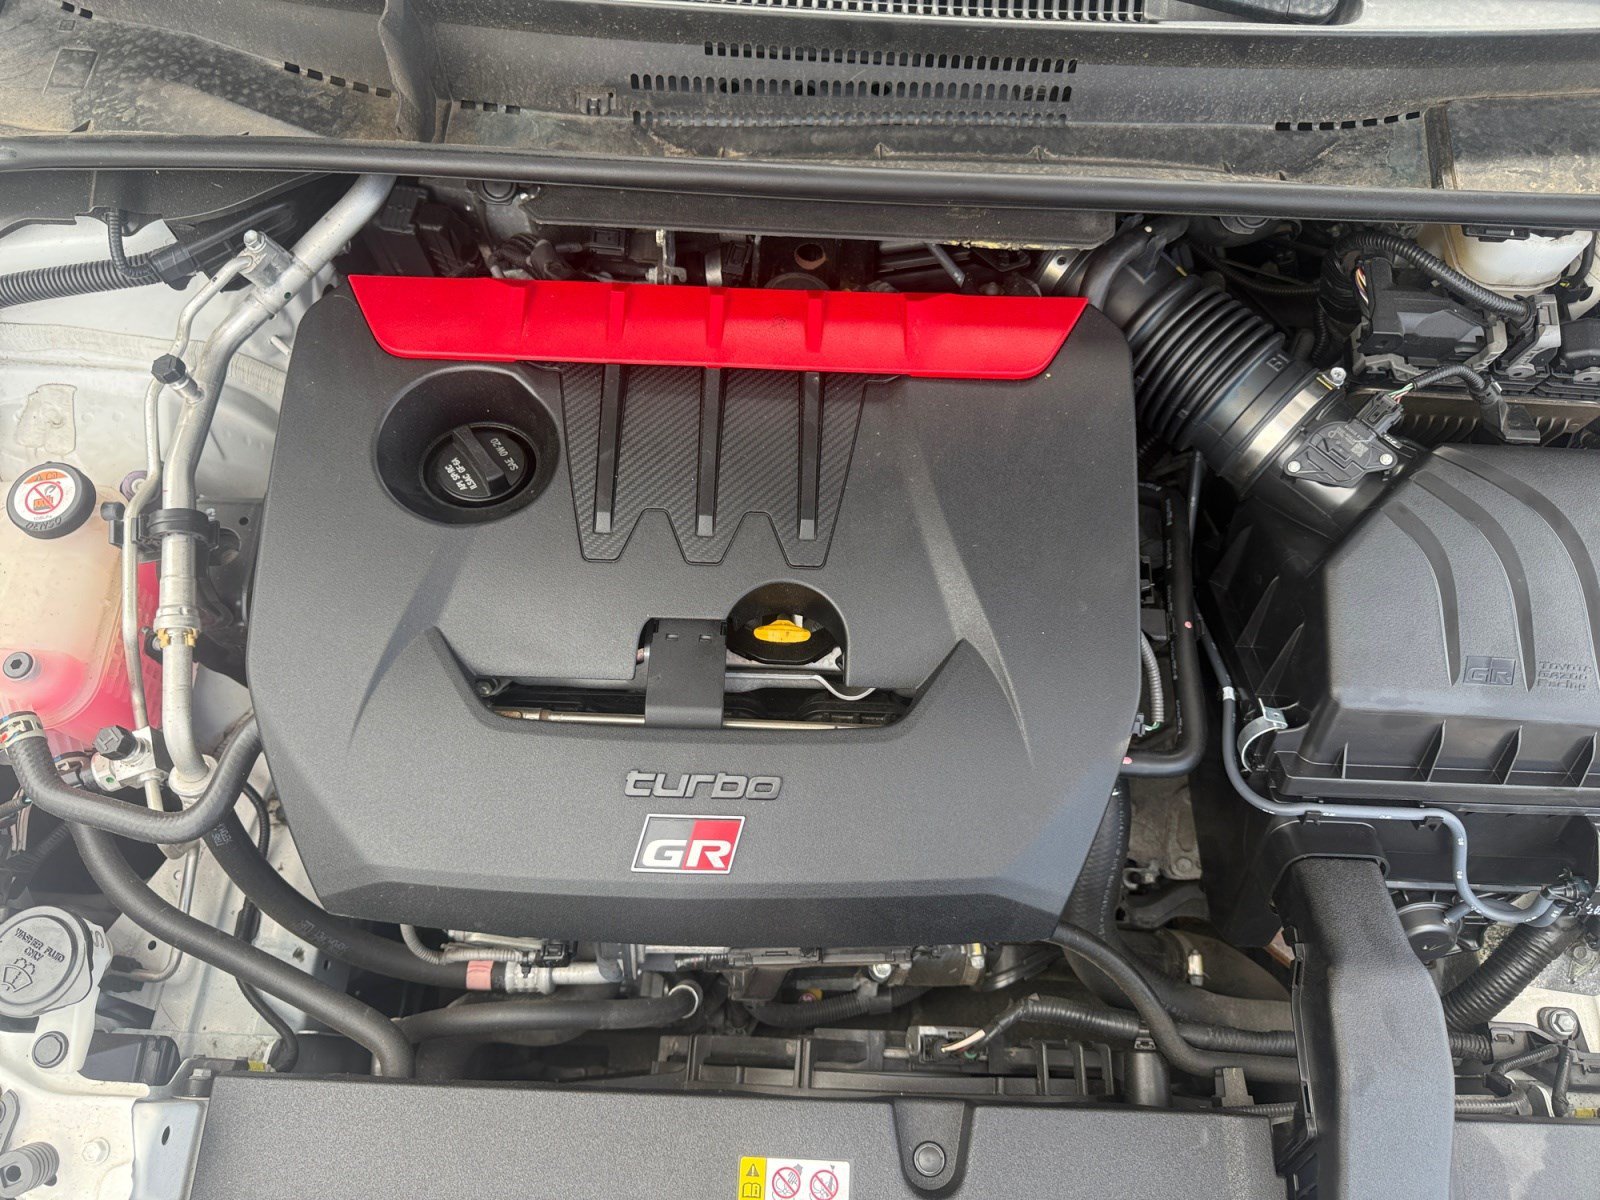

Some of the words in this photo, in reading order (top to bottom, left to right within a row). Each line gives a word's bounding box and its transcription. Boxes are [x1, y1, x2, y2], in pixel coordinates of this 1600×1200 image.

[490, 438, 508, 457] 0W-20
[504, 457, 518, 471] SAE
[1466, 667, 1514, 685] GR
[624, 770, 783, 801] turbo
[641, 839, 732, 869] GR
[15, 928, 44, 951] WASHER
[43, 946, 65, 962] FLUID
[24, 947, 44, 961] ONLY
